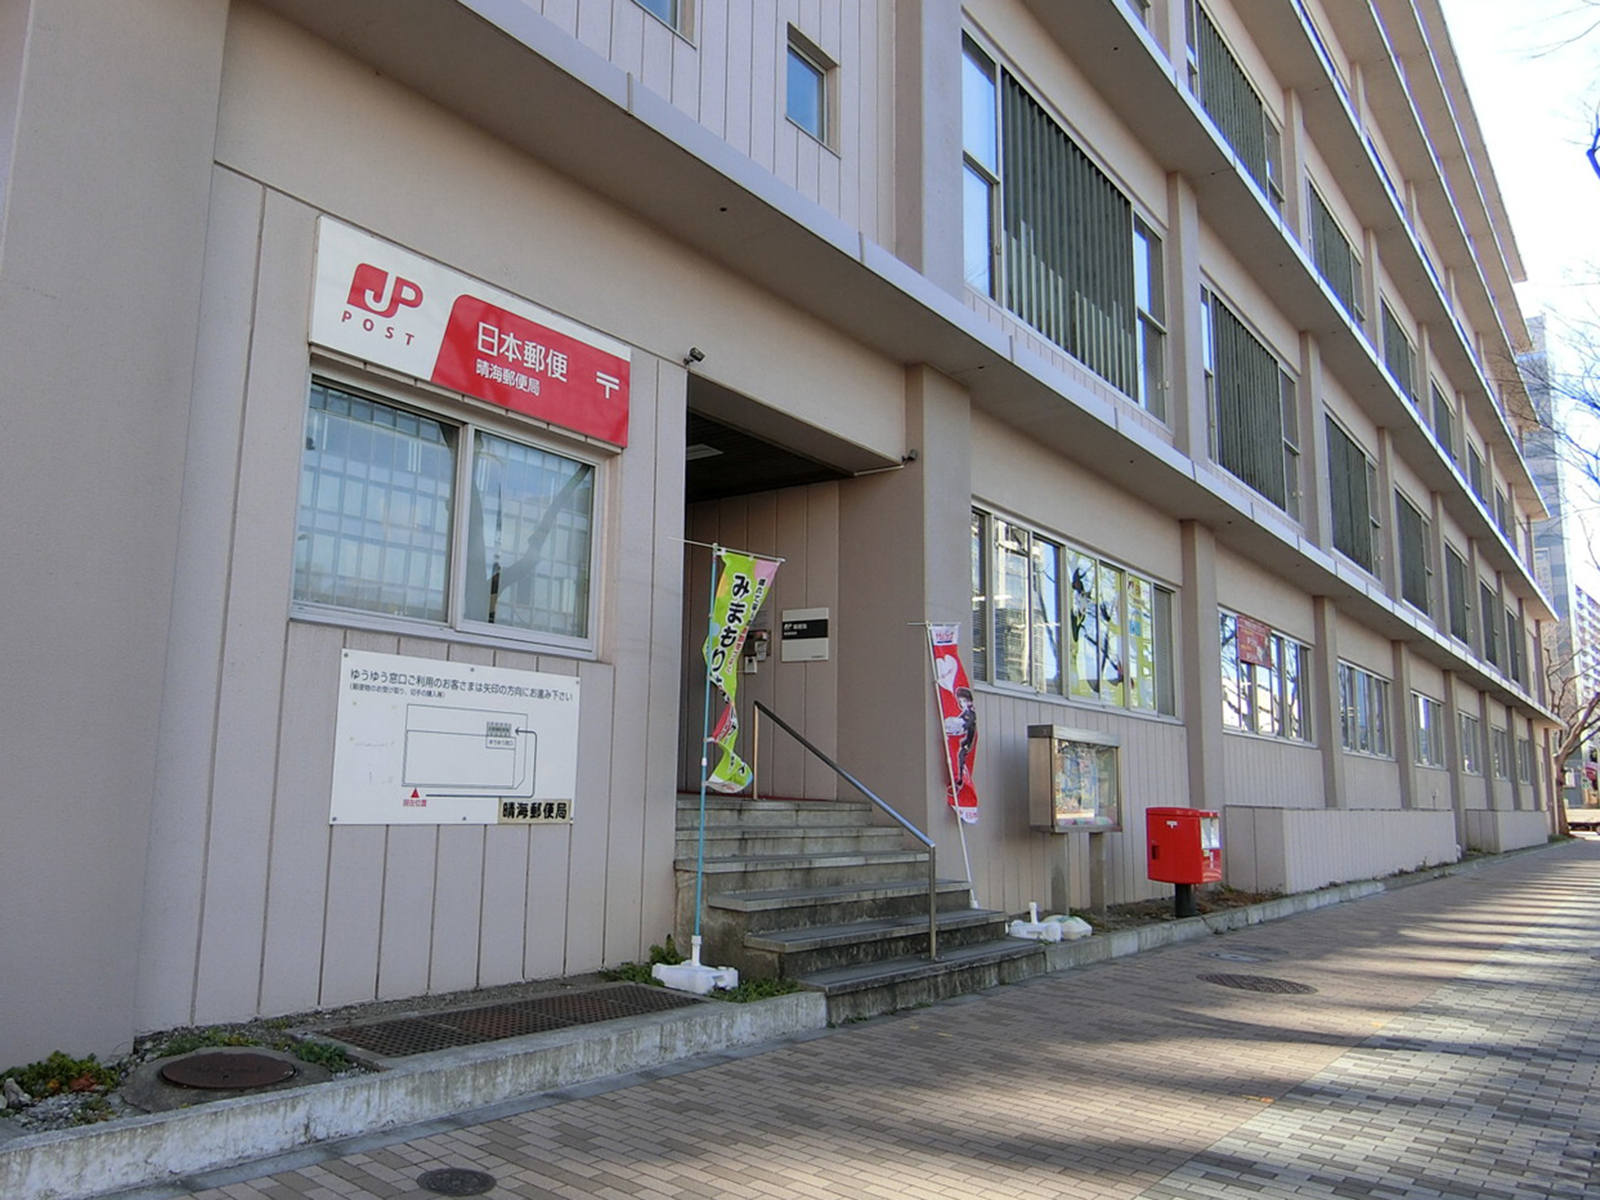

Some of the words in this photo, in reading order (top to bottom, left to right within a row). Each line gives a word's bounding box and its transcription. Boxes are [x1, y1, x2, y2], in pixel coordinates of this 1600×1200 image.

[347, 263, 424, 318] JP
[341, 310, 416, 347] POST
[477, 321, 568, 383] 日本郵便
[475, 358, 541, 397] 晴海郵便局
[350, 669, 574, 702] ゆうゆう窓口ご利用のお客さまは矢印の方向にお進み下さい
[502, 802, 568, 820] 晴海郵便局
